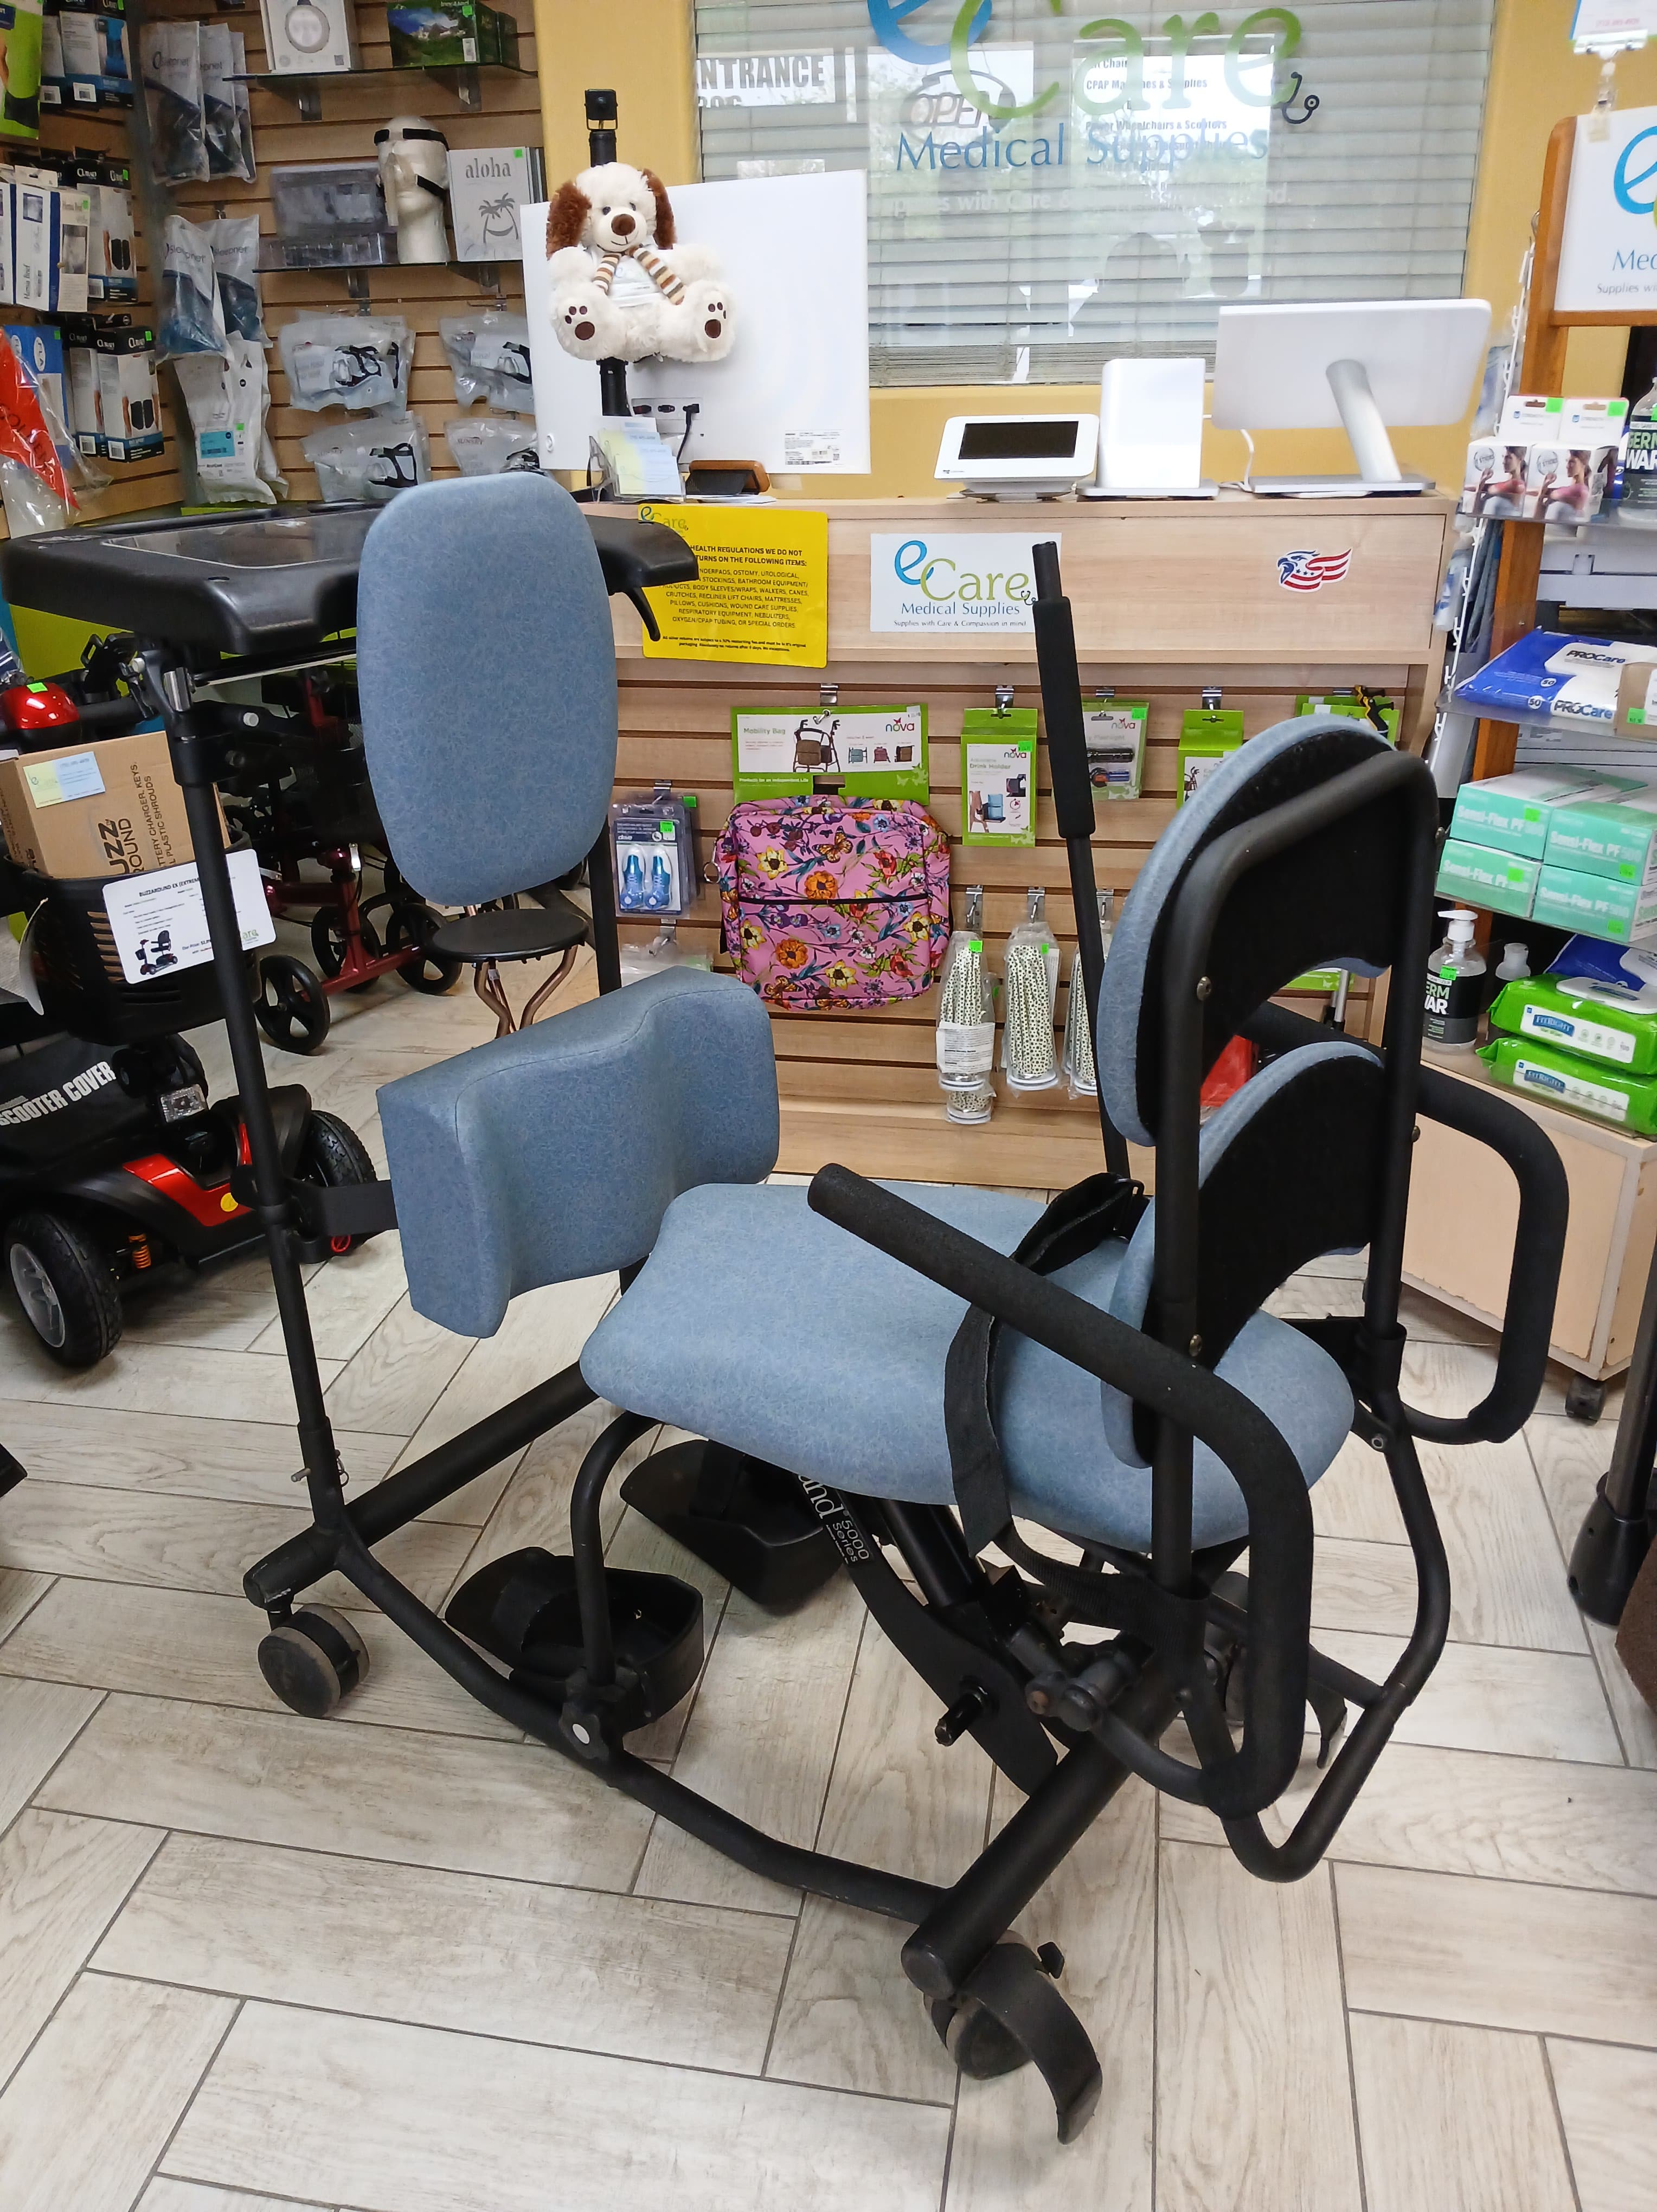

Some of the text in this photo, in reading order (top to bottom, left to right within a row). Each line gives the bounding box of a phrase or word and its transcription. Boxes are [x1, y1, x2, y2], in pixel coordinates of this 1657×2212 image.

[696, 55, 824, 90] NTRANCE
[1086, 80, 1109, 90] CPAP
[1167, 79, 1208, 89] Splies
[896, 118, 1268, 173] Medical Supplies
[465, 157, 511, 179] aloha
[1597, 283, 1639, 295] Supplies
[744, 557, 784, 565] FOLLOWING
[895, 540, 1029, 601] eCare
[901, 601, 1020, 618] Medical Supplies
[1566, 650, 1626, 664] PROCare
[1529, 698, 1541, 706] 50
[1553, 699, 1613, 719] PROCare
[885, 718, 915, 732] nova
[1004, 749, 1027, 758] nova
[144, 775, 174, 857] PLASTIC SHROUDS
[98, 819, 130, 874] UZZ
[118, 818, 145, 873] ROUND
[151, 838, 165, 866] TTERY
[138, 884, 172, 897] BUZZAROUND
[242, 929, 258, 940] are
[0, 1089, 68, 1126] SCOOTER
[62, 1061, 117, 1102] COVER
[841, 1519, 869, 1560] 5000
